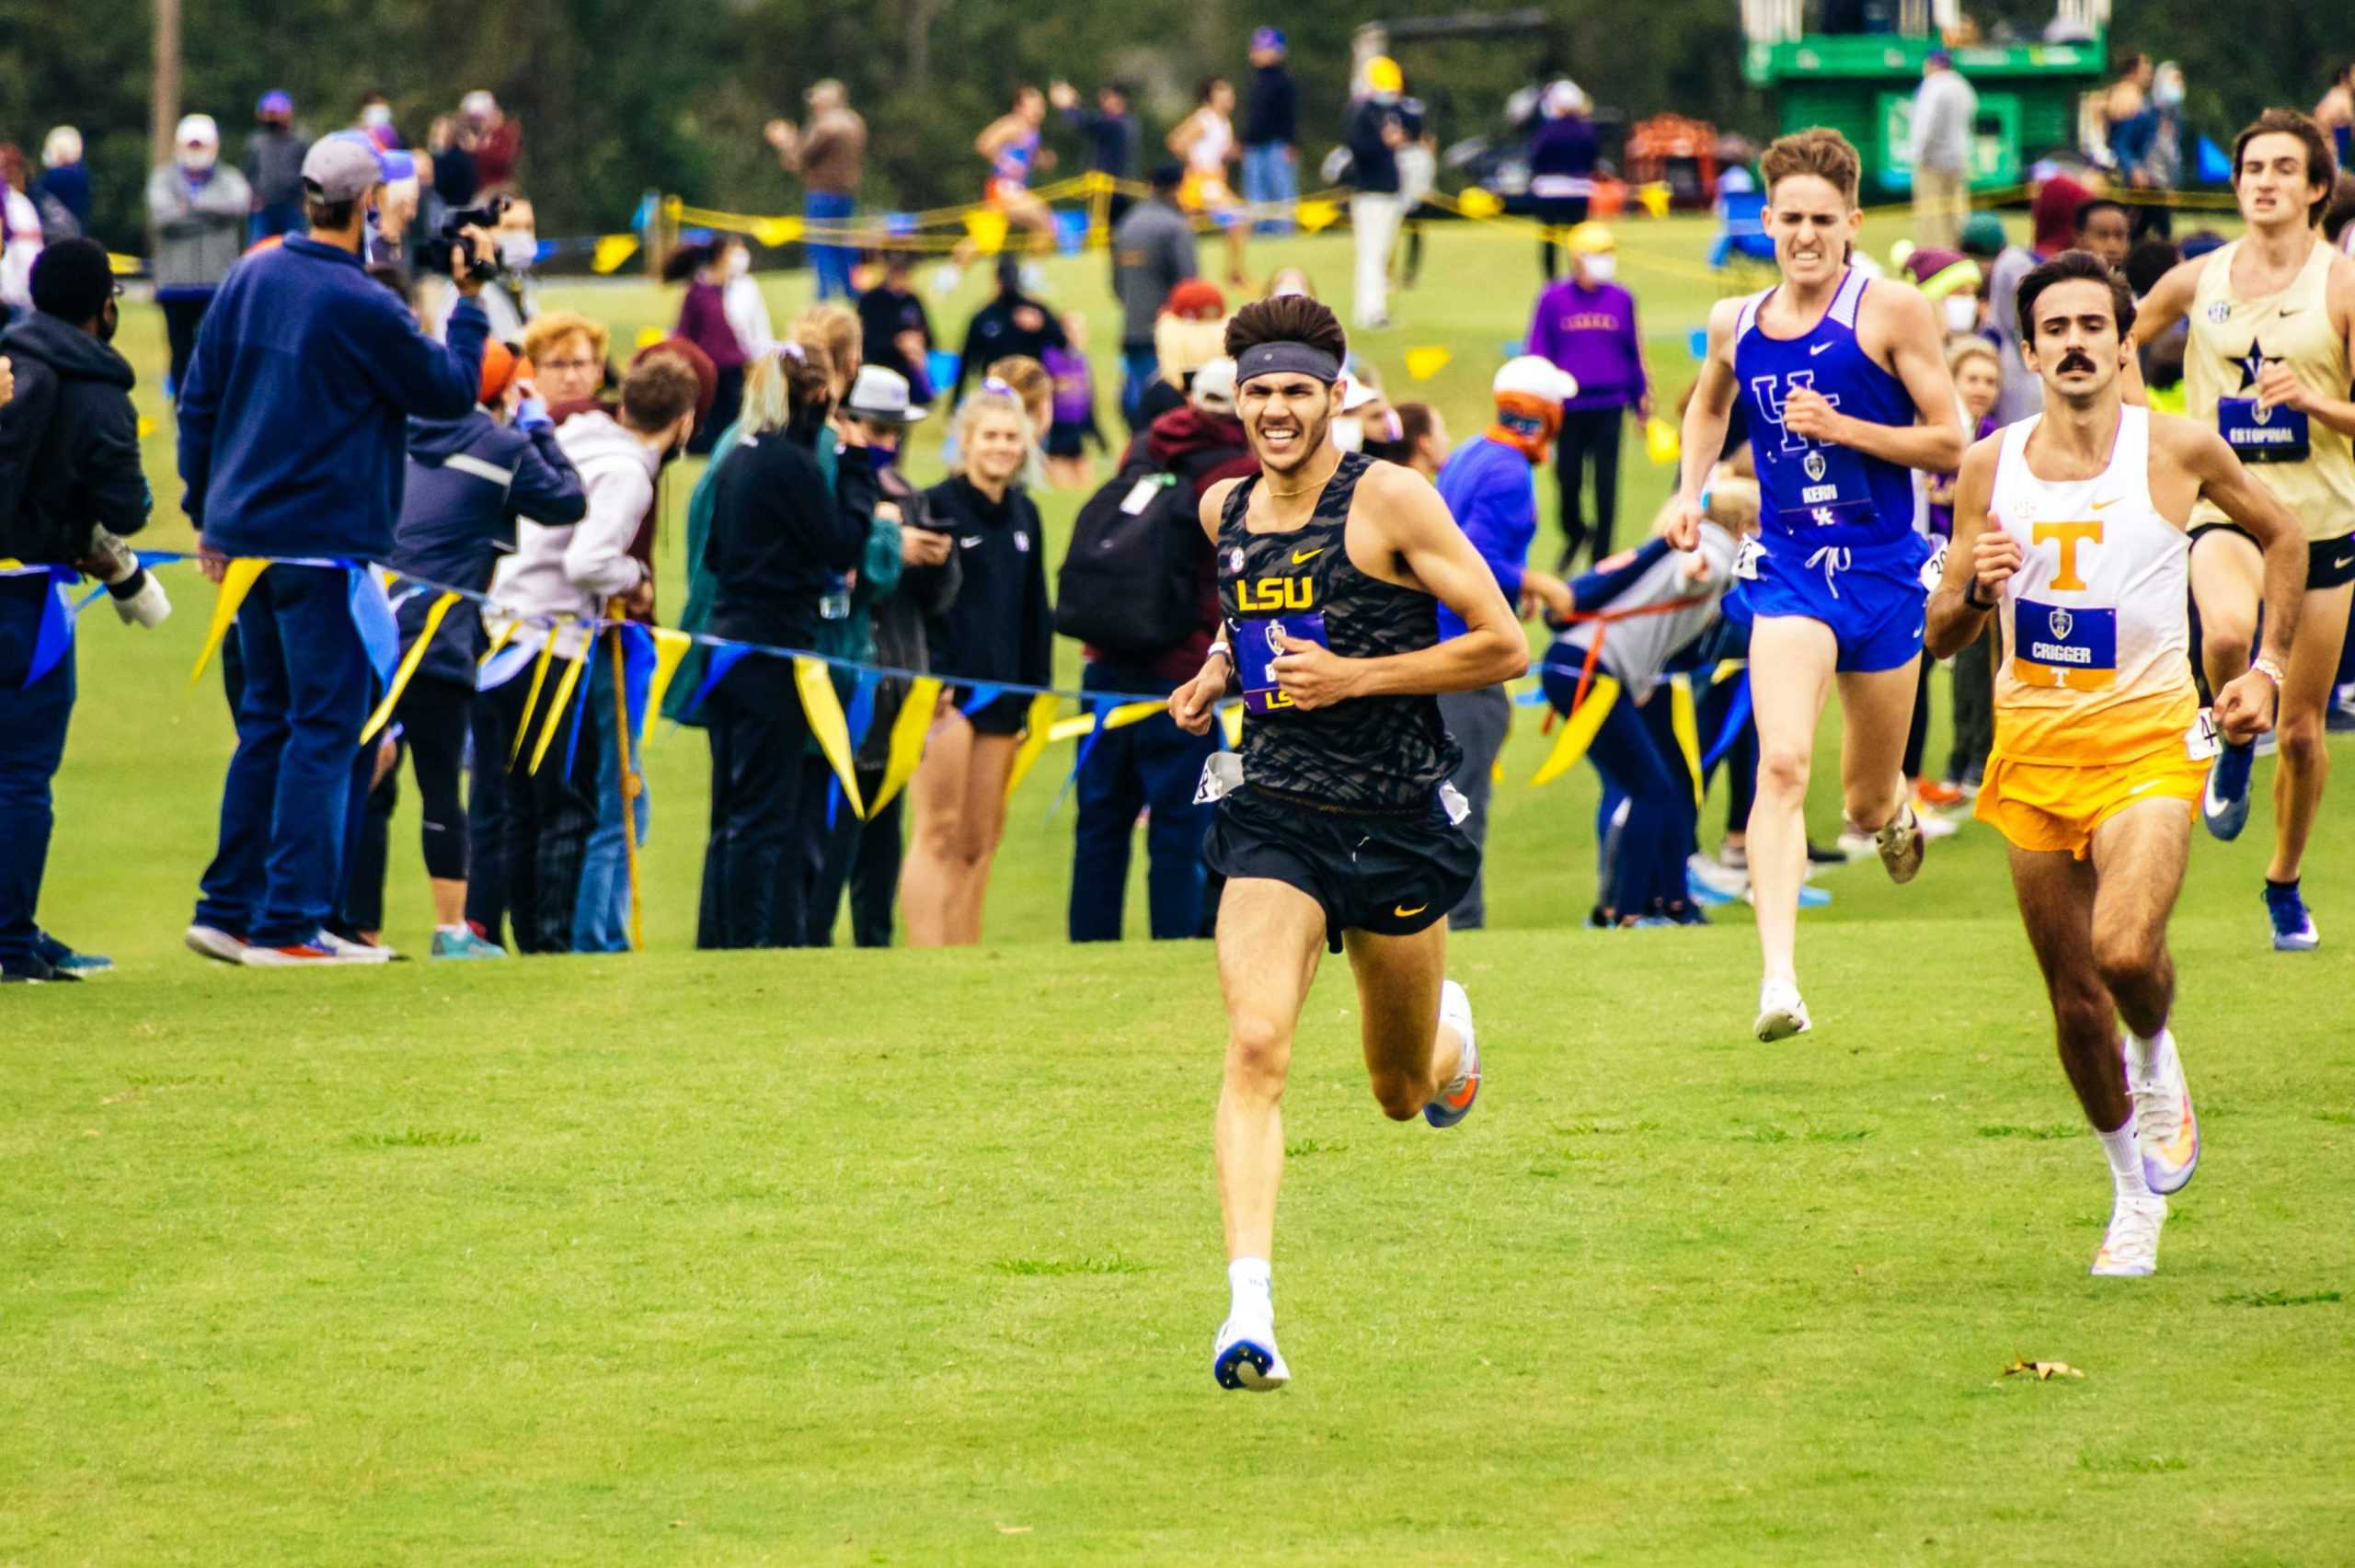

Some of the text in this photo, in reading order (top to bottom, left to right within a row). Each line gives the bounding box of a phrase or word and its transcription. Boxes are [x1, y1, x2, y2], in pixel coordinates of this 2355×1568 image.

[2032, 521, 2104, 590] T
[1236, 576, 1314, 612] LSU
[2032, 642, 2091, 664] CRIGGER
[2051, 666, 2071, 688] T
[1265, 690, 1295, 709] LS
